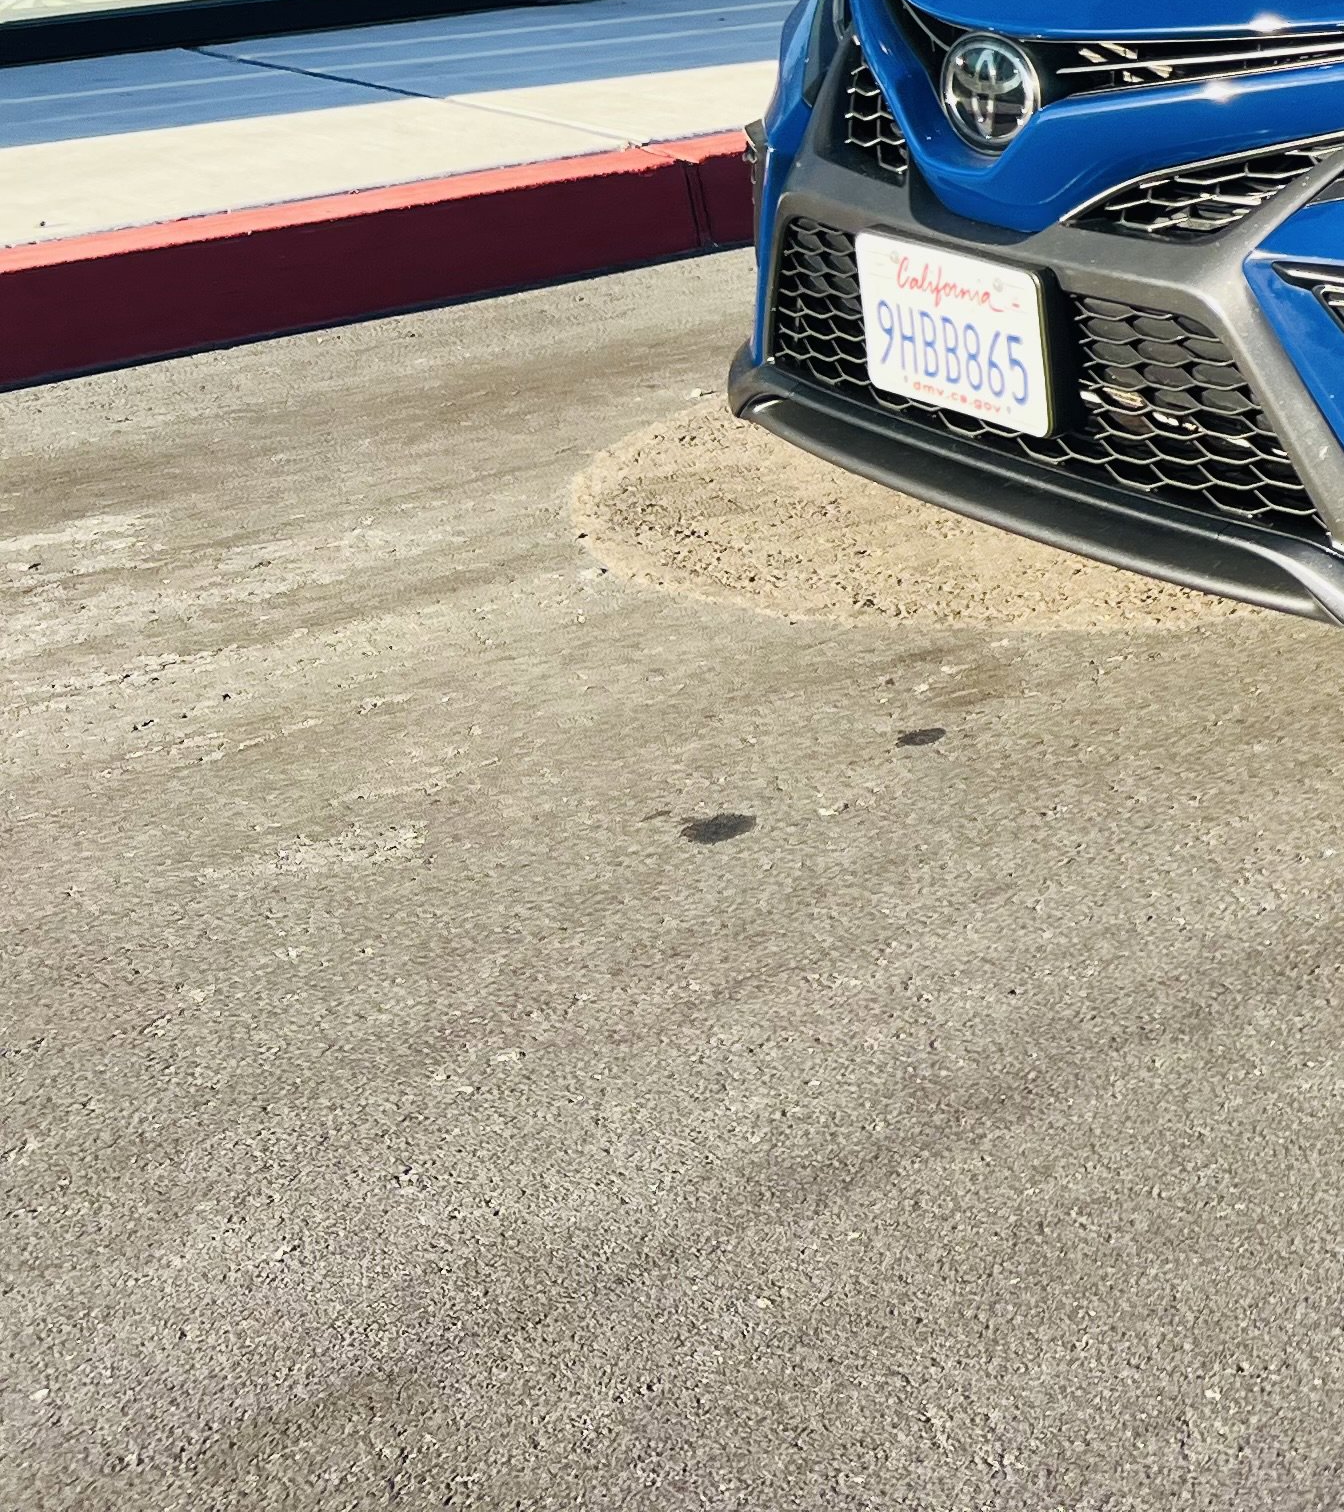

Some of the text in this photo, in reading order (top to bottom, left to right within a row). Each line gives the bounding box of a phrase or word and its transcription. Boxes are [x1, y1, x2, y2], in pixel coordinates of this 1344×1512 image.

[897, 257, 1004, 312] California
[877, 300, 1029, 406] 9HBB865
[913, 380, 1001, 413] dmv.ca.gov
